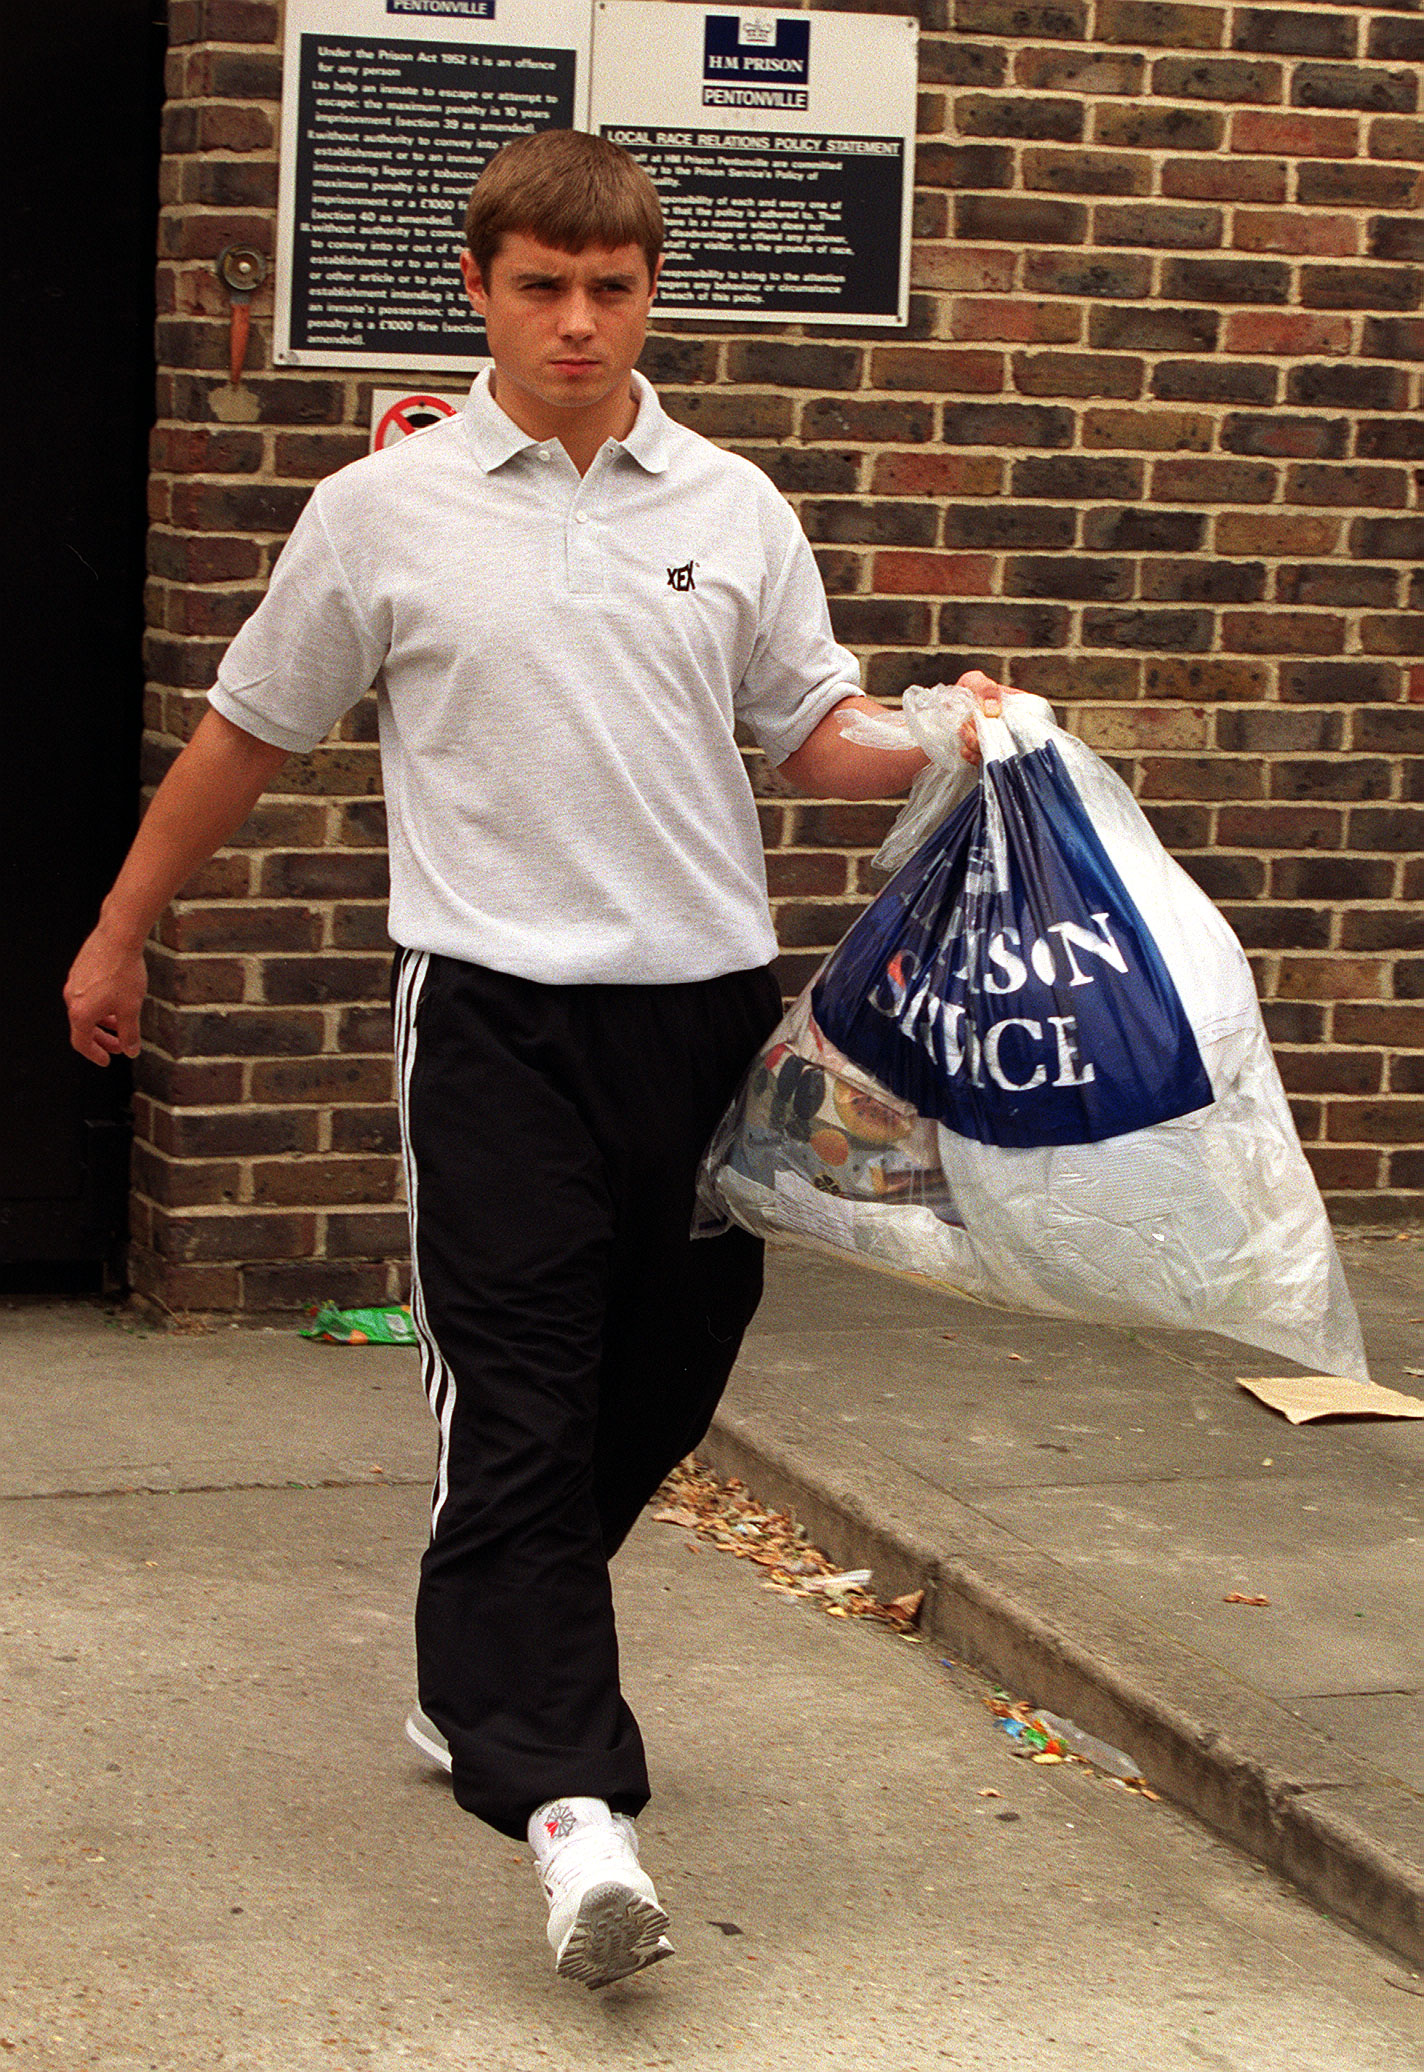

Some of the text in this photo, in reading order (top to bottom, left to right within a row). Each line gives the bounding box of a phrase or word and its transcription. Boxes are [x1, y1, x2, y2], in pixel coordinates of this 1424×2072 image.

[393, 0, 488, 15] PENTONVILLE
[317, 46, 351, 58] Under
[355, 48, 374, 59] the
[378, 49, 413, 61] Prison
[417, 51, 437, 63] Act
[440, 53, 466, 64] 1952
[496, 59, 511, 67] an
[514, 57, 556, 69] offence
[708, 55, 804, 73] HM PRISON
[318, 63, 400, 78] for any person
[333, 81, 357, 94] help
[362, 85, 376, 93] an
[380, 83, 418, 95] inmate
[438, 90, 477, 101] escape
[497, 92, 541, 105] attempt
[705, 89, 806, 108] PENTONVILLE
[363, 99, 382, 109] the
[386, 100, 441, 112] maximum
[445, 103, 486, 117] penalty
[520, 110, 549, 120] years
[315, 112, 391, 128] imprisonment
[443, 118, 458, 129] 39
[363, 132, 413, 147] authority
[433, 139, 472, 149] convey
[476, 138, 498, 148] into
[607, 131, 900, 155] LOCAL RACE RELATIONS POLICY STATEMENT
[314, 146, 392, 159] establishment
[446, 152, 484, 163] inmate
[313, 161, 378, 177] intoxicating
[382, 165, 413, 178] liquor
[312, 178, 368, 190] maximum
[372, 180, 413, 194] penalty
[312, 193, 387, 208] imprisonment
[420, 198, 454, 209] £1000
[359, 211, 375, 221] 40
[359, 224, 410, 238] authority
[327, 242, 366, 252] convey
[370, 241, 392, 251] into
[412, 244, 431, 252] out
[310, 254, 387, 266] establishment
[325, 270, 354, 281] other
[359, 272, 394, 282] article
[430, 274, 459, 287] place
[309, 286, 386, 298] establishment
[390, 289, 441, 302] intending
[447, 307, 466, 317] the
[307, 317, 348, 331] penalty
[379, 320, 413, 331] £1000
[417, 321, 438, 331] fine
